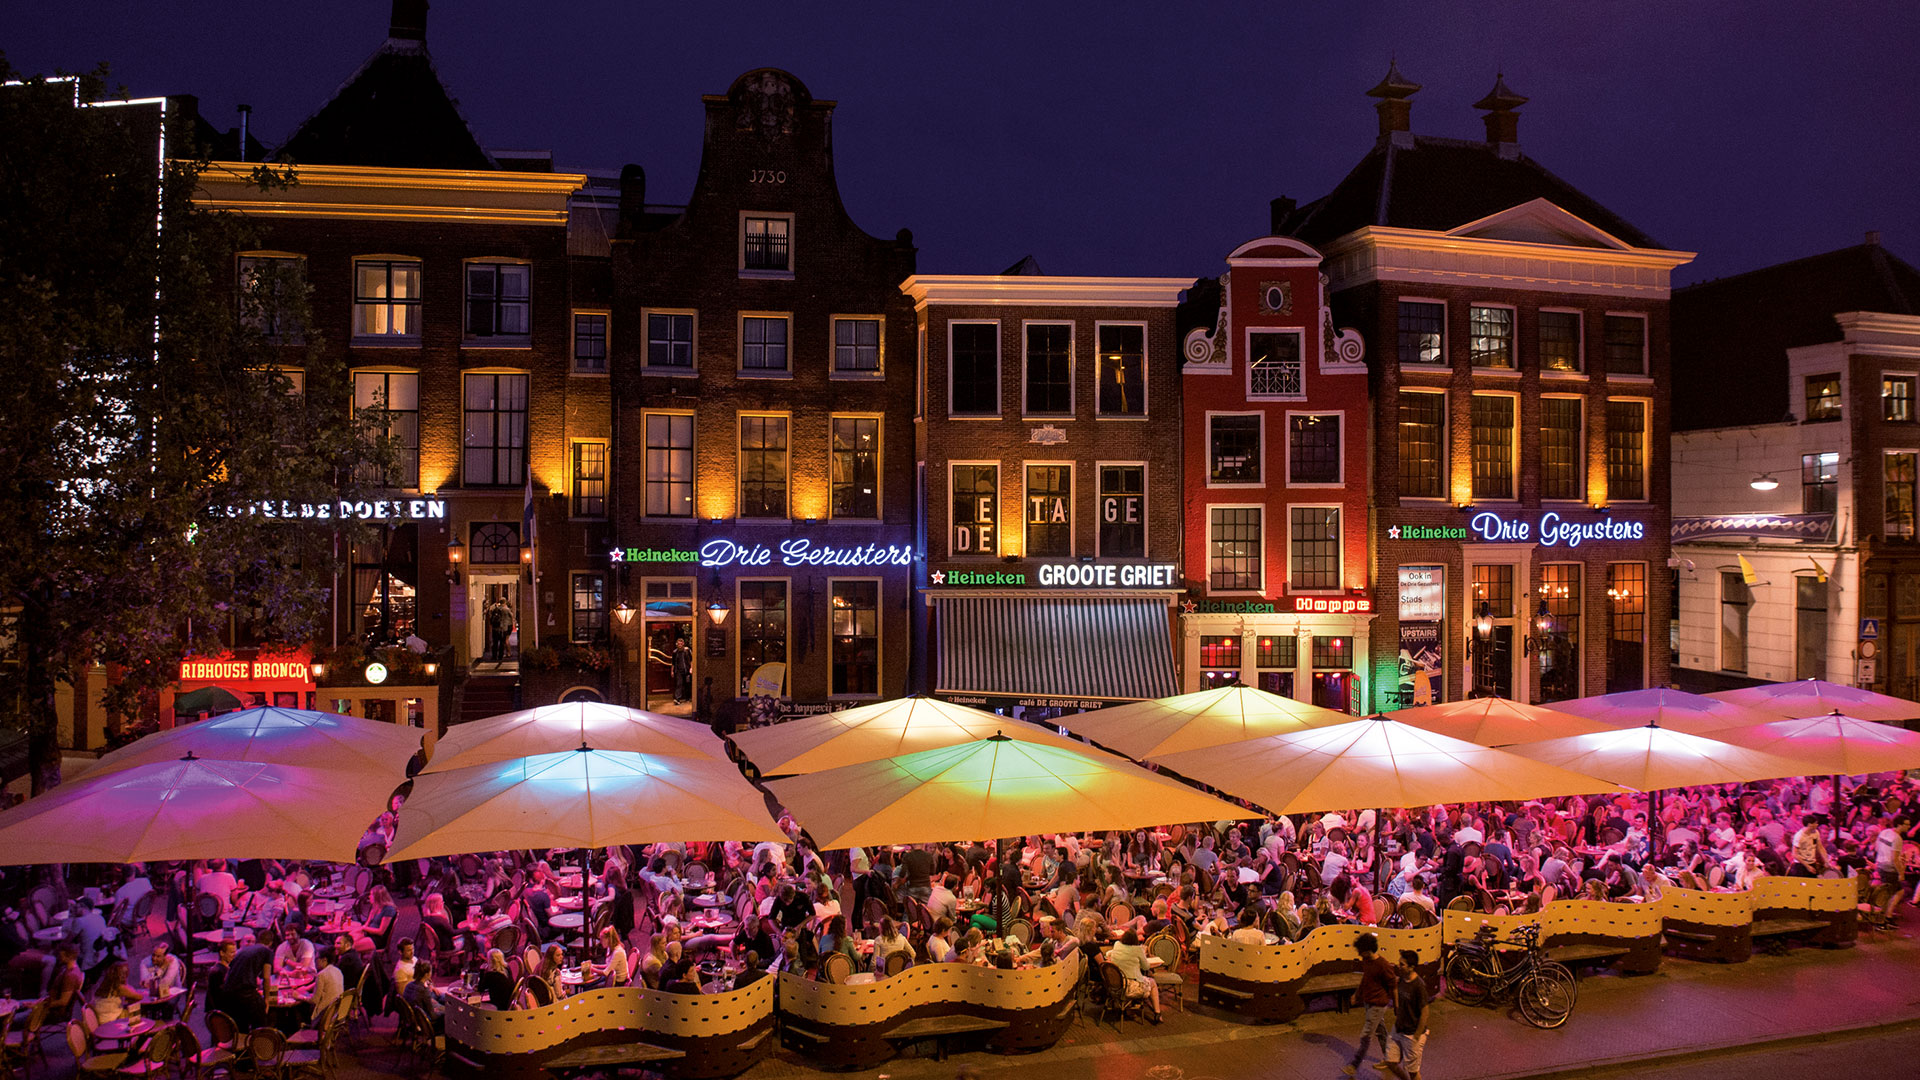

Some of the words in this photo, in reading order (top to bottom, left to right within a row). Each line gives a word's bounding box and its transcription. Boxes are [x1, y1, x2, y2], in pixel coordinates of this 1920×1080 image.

[1402, 526, 1467, 539] Heineken
[1471, 512, 1530, 541] Drie
[1539, 511, 1644, 548] Gezusters
[626, 548, 699, 562] Heineken
[701, 539, 771, 566] Drie
[779, 539, 912, 566] Gezusters
[947, 570, 1026, 585] Heineken
[1039, 564, 1117, 586] GROOTE
[1120, 564, 1176, 586] GRIET
[1409, 572, 1423, 580] Ook
[1296, 598, 1371, 613] Hoppe
[1401, 595, 1422, 603] Stads
[1201, 600, 1275, 613] Heineken
[182, 662, 249, 679] RIBHOUSE
[253, 662, 305, 679] BRONCO
[953, 696, 987, 704] Heineken
[1049, 700, 1078, 708] GROOTE
[1080, 701, 1103, 709] GRIET
